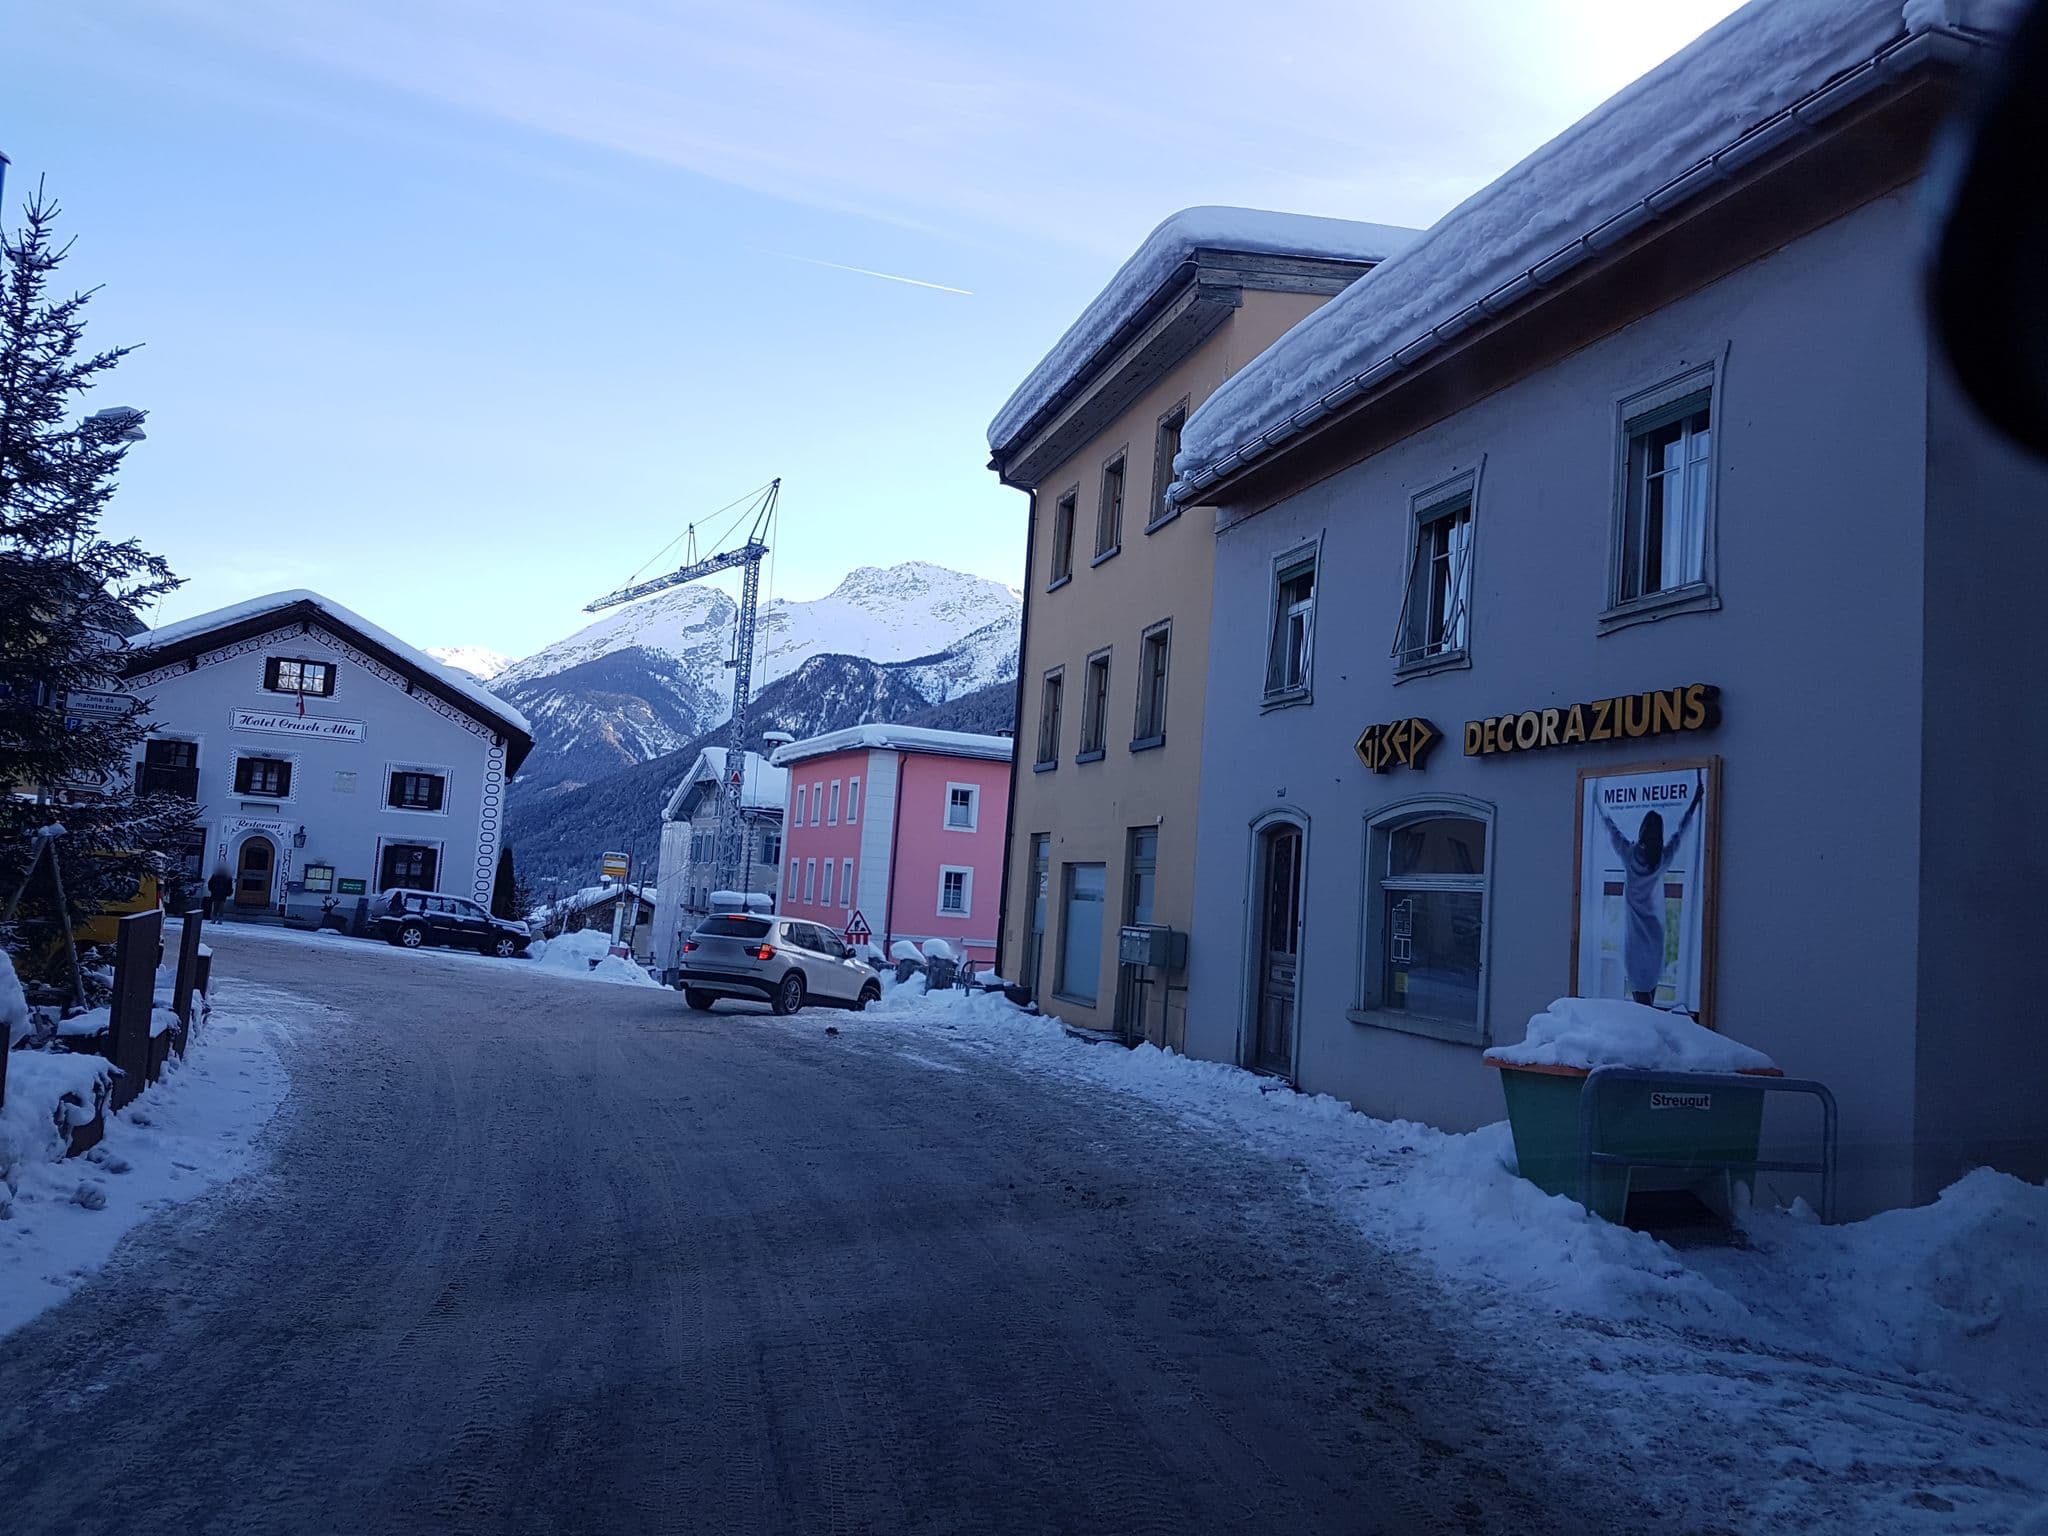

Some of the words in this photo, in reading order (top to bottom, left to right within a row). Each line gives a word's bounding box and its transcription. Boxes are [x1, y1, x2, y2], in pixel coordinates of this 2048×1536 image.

[239, 715, 276, 728] Hotel
[323, 724, 356, 736] Alba
[1464, 683, 1711, 757] DECORAZIUNS
[1604, 787, 1637, 804] MEIN
[1642, 784, 1688, 801] NEUER
[1652, 1094, 1709, 1109] Streugut
